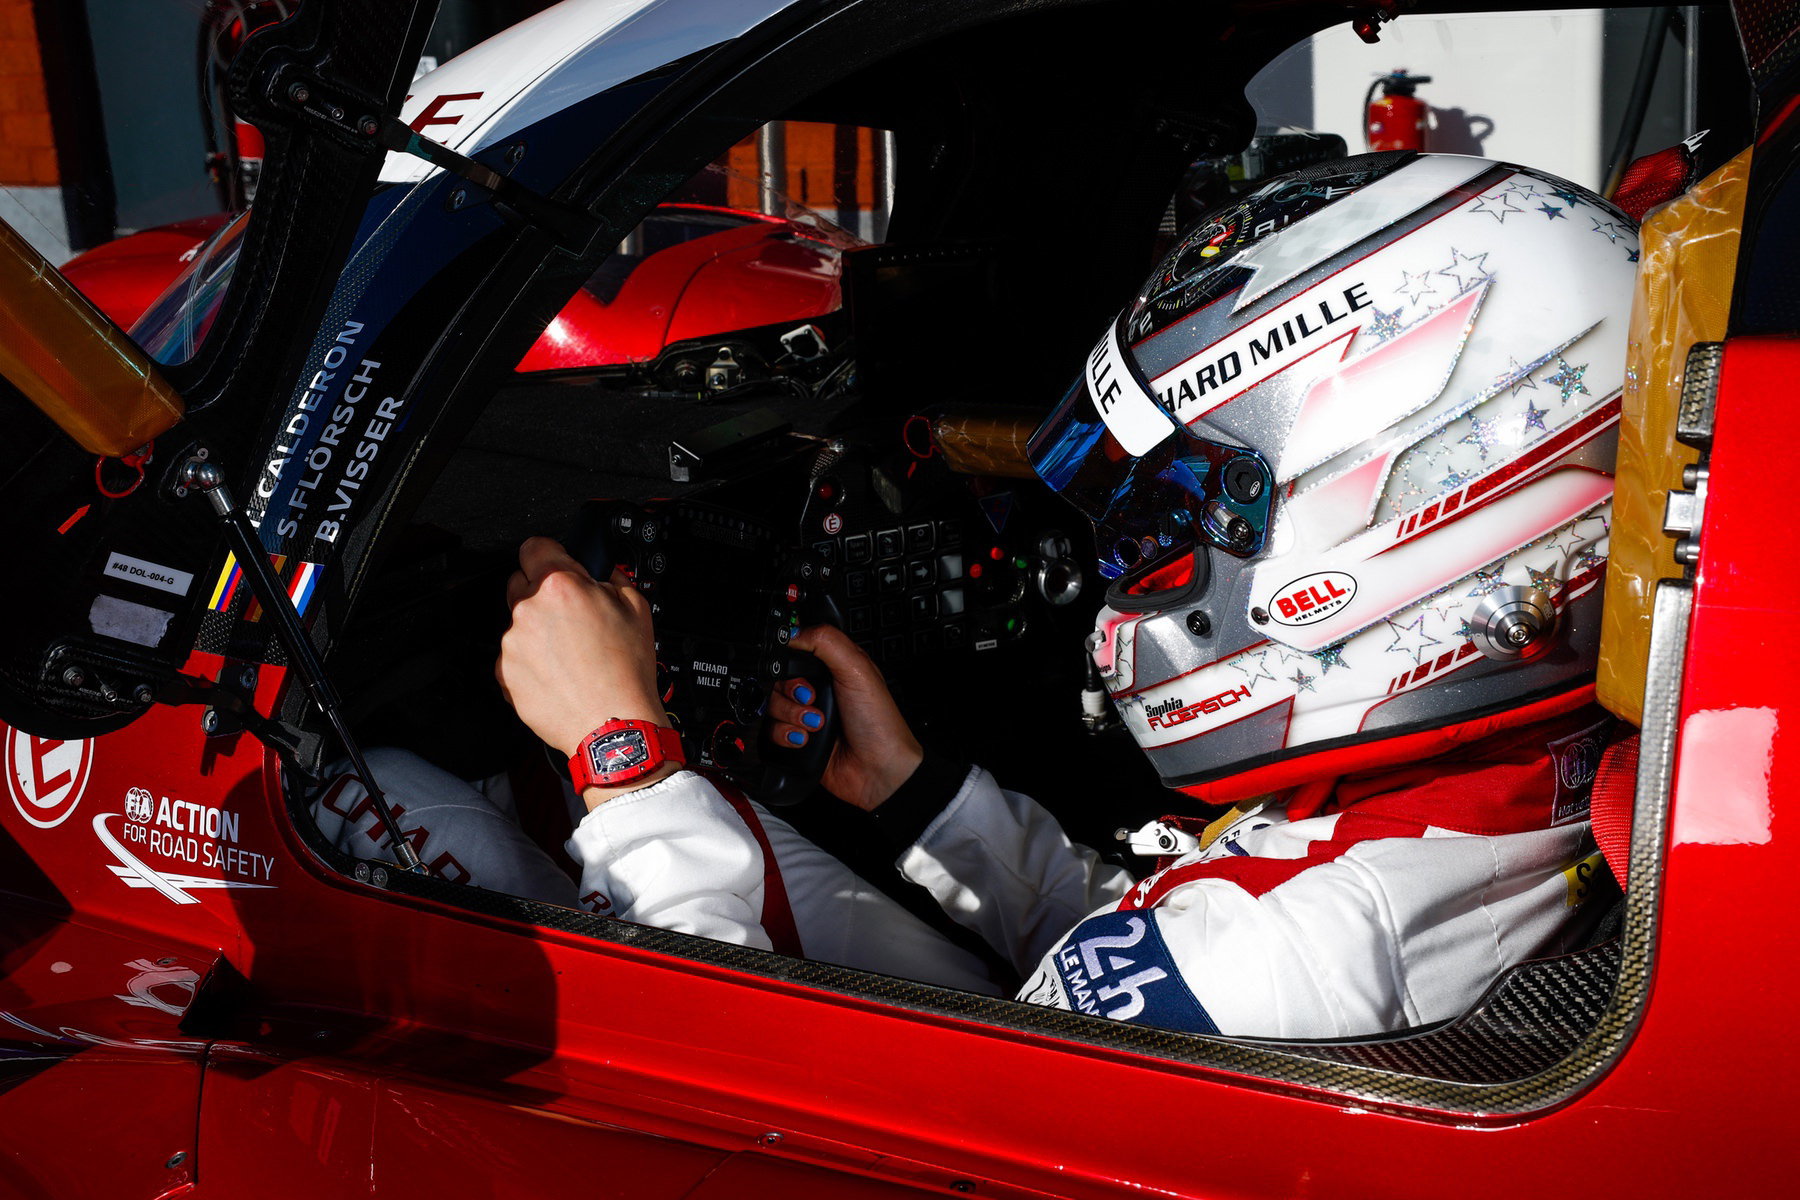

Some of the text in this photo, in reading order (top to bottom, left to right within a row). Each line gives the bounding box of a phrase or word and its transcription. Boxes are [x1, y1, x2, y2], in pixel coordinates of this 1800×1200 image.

[1248, 282, 1373, 366] MILLE
[1091, 331, 1122, 415] ILLE
[315, 396, 404, 543] B.VISSER
[112, 561, 175, 585] #48 DOL-004-G
[1276, 579, 1347, 619] BELL
[1294, 600, 1342, 622] HELMETS
[692, 660, 728, 675] RICHARD
[696, 675, 721, 688] MILLE
[1144, 697, 1184, 719] Sophia
[155, 796, 240, 843] ACTION
[123, 822, 275, 881] FOR ROAD SAFETY
[1059, 943, 1081, 972] LE
